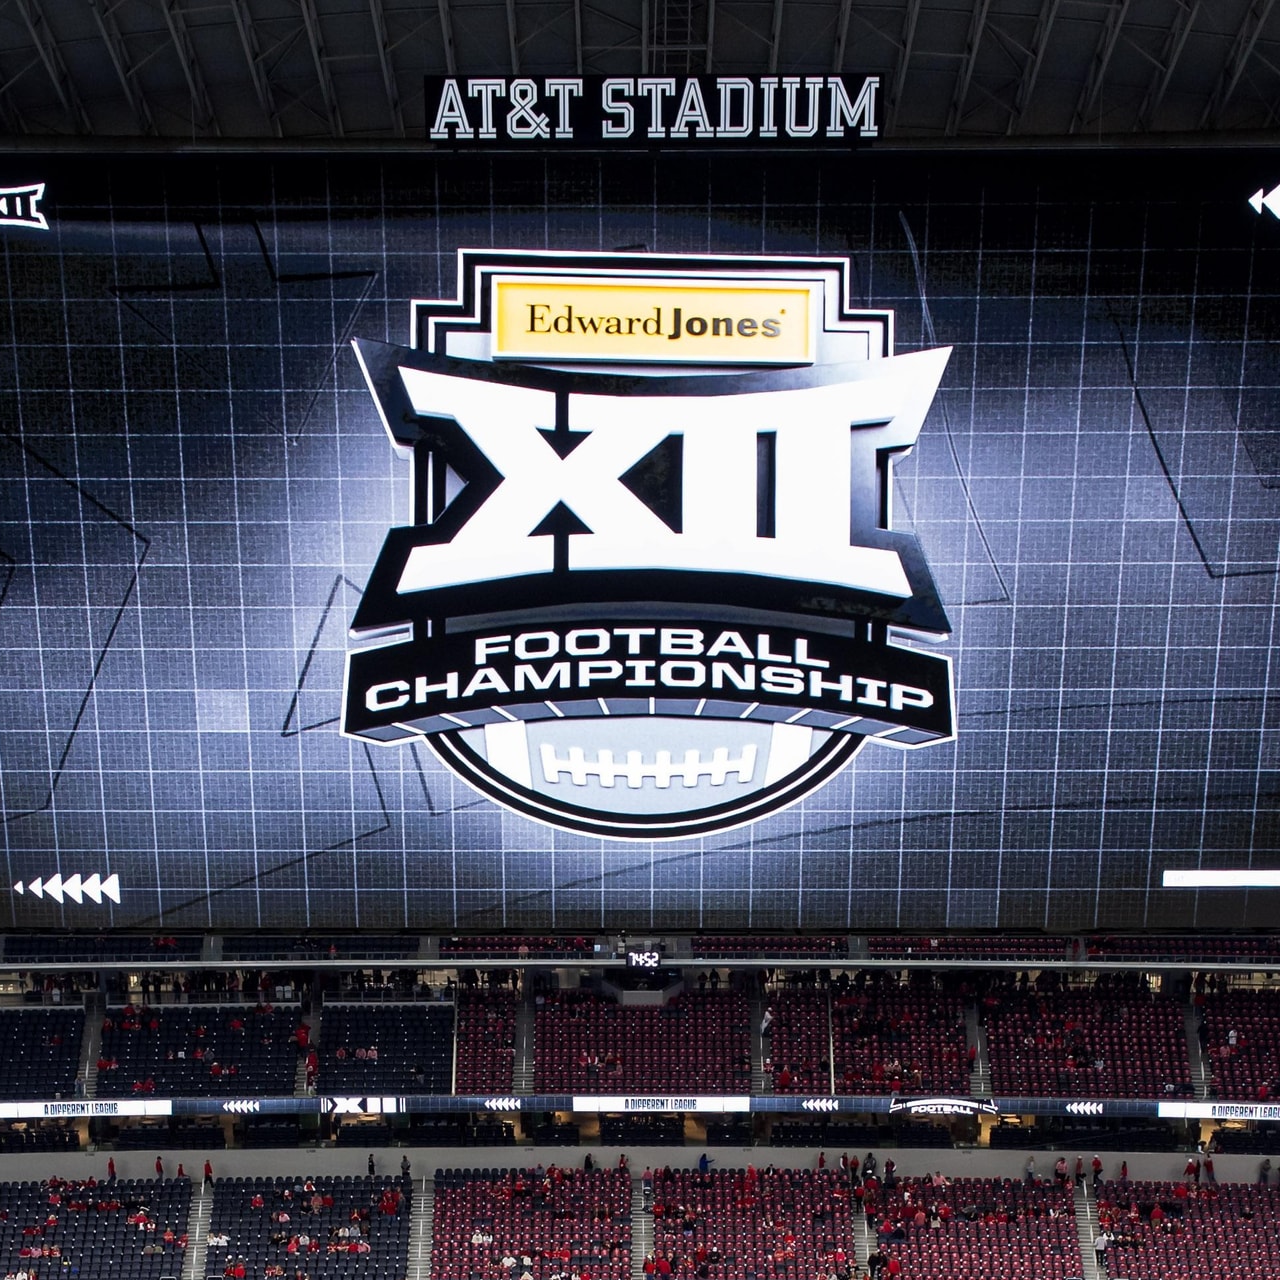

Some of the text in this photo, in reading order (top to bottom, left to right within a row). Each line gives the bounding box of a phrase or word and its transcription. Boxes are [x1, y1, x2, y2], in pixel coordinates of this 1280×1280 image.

[430, 77, 881, 139] AT&T STADIUM
[397, 346, 952, 597] XII
[474, 628, 829, 667] FOOTBALL
[365, 660, 934, 712] CHAMPIONSHIP
[44, 1102, 118, 1116] A DIFFERENT LEAGUE
[625, 1099, 697, 1110] A DIFFERENT LEAGUE
[911, 1104, 973, 1115] FOOTBALL
[1211, 1106, 1217, 1117] A
[1218, 1106, 1259, 1118] DIFFERENT
